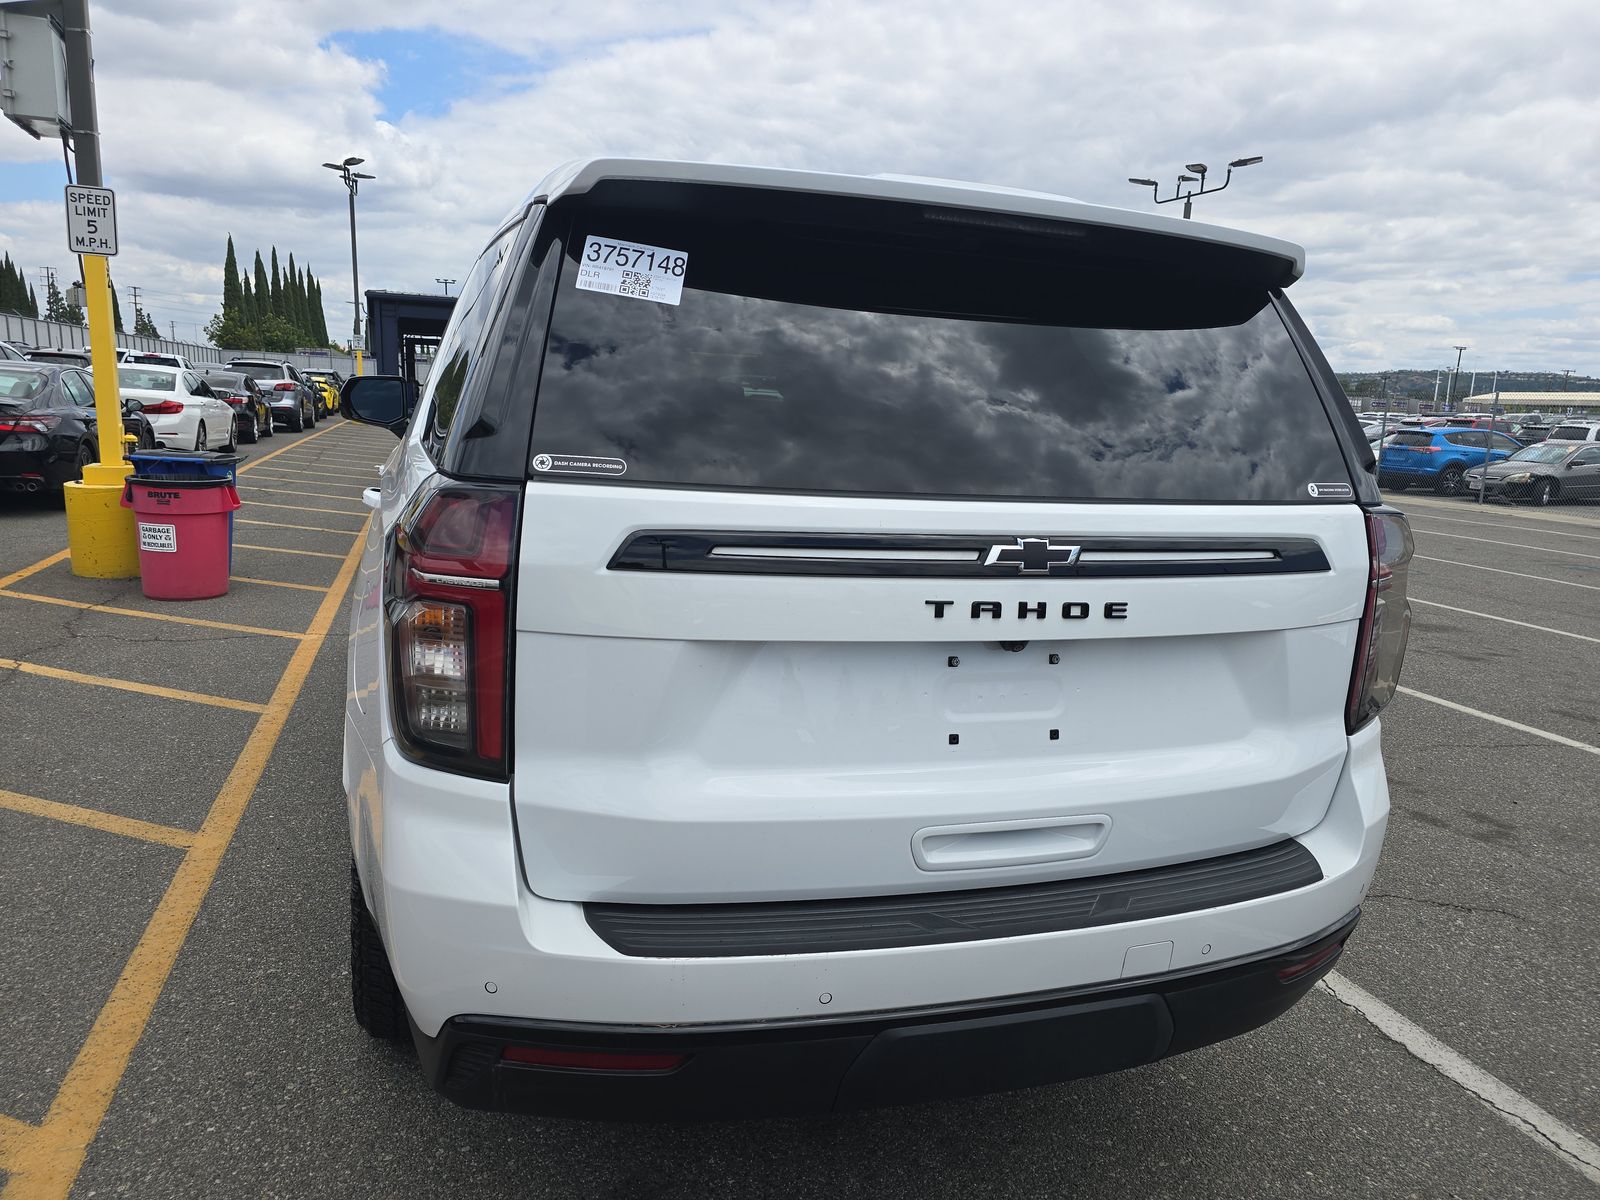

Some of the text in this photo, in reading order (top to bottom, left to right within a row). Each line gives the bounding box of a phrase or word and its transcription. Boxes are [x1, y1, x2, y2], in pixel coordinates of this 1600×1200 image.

[70, 192, 111, 206] SPEED
[75, 205, 108, 218] LIMIT
[87, 219, 98, 234] 5
[75, 236, 112, 249] M.P.H.
[586, 242, 686, 277] 3757148
[580, 269, 600, 279] DLR
[592, 462, 623, 470] RECORDING
[147, 490, 181, 499] BRUTE
[141, 526, 171, 534] GARBAGE
[147, 533, 163, 541] ONLY
[925, 599, 1129, 619] TAHOE
